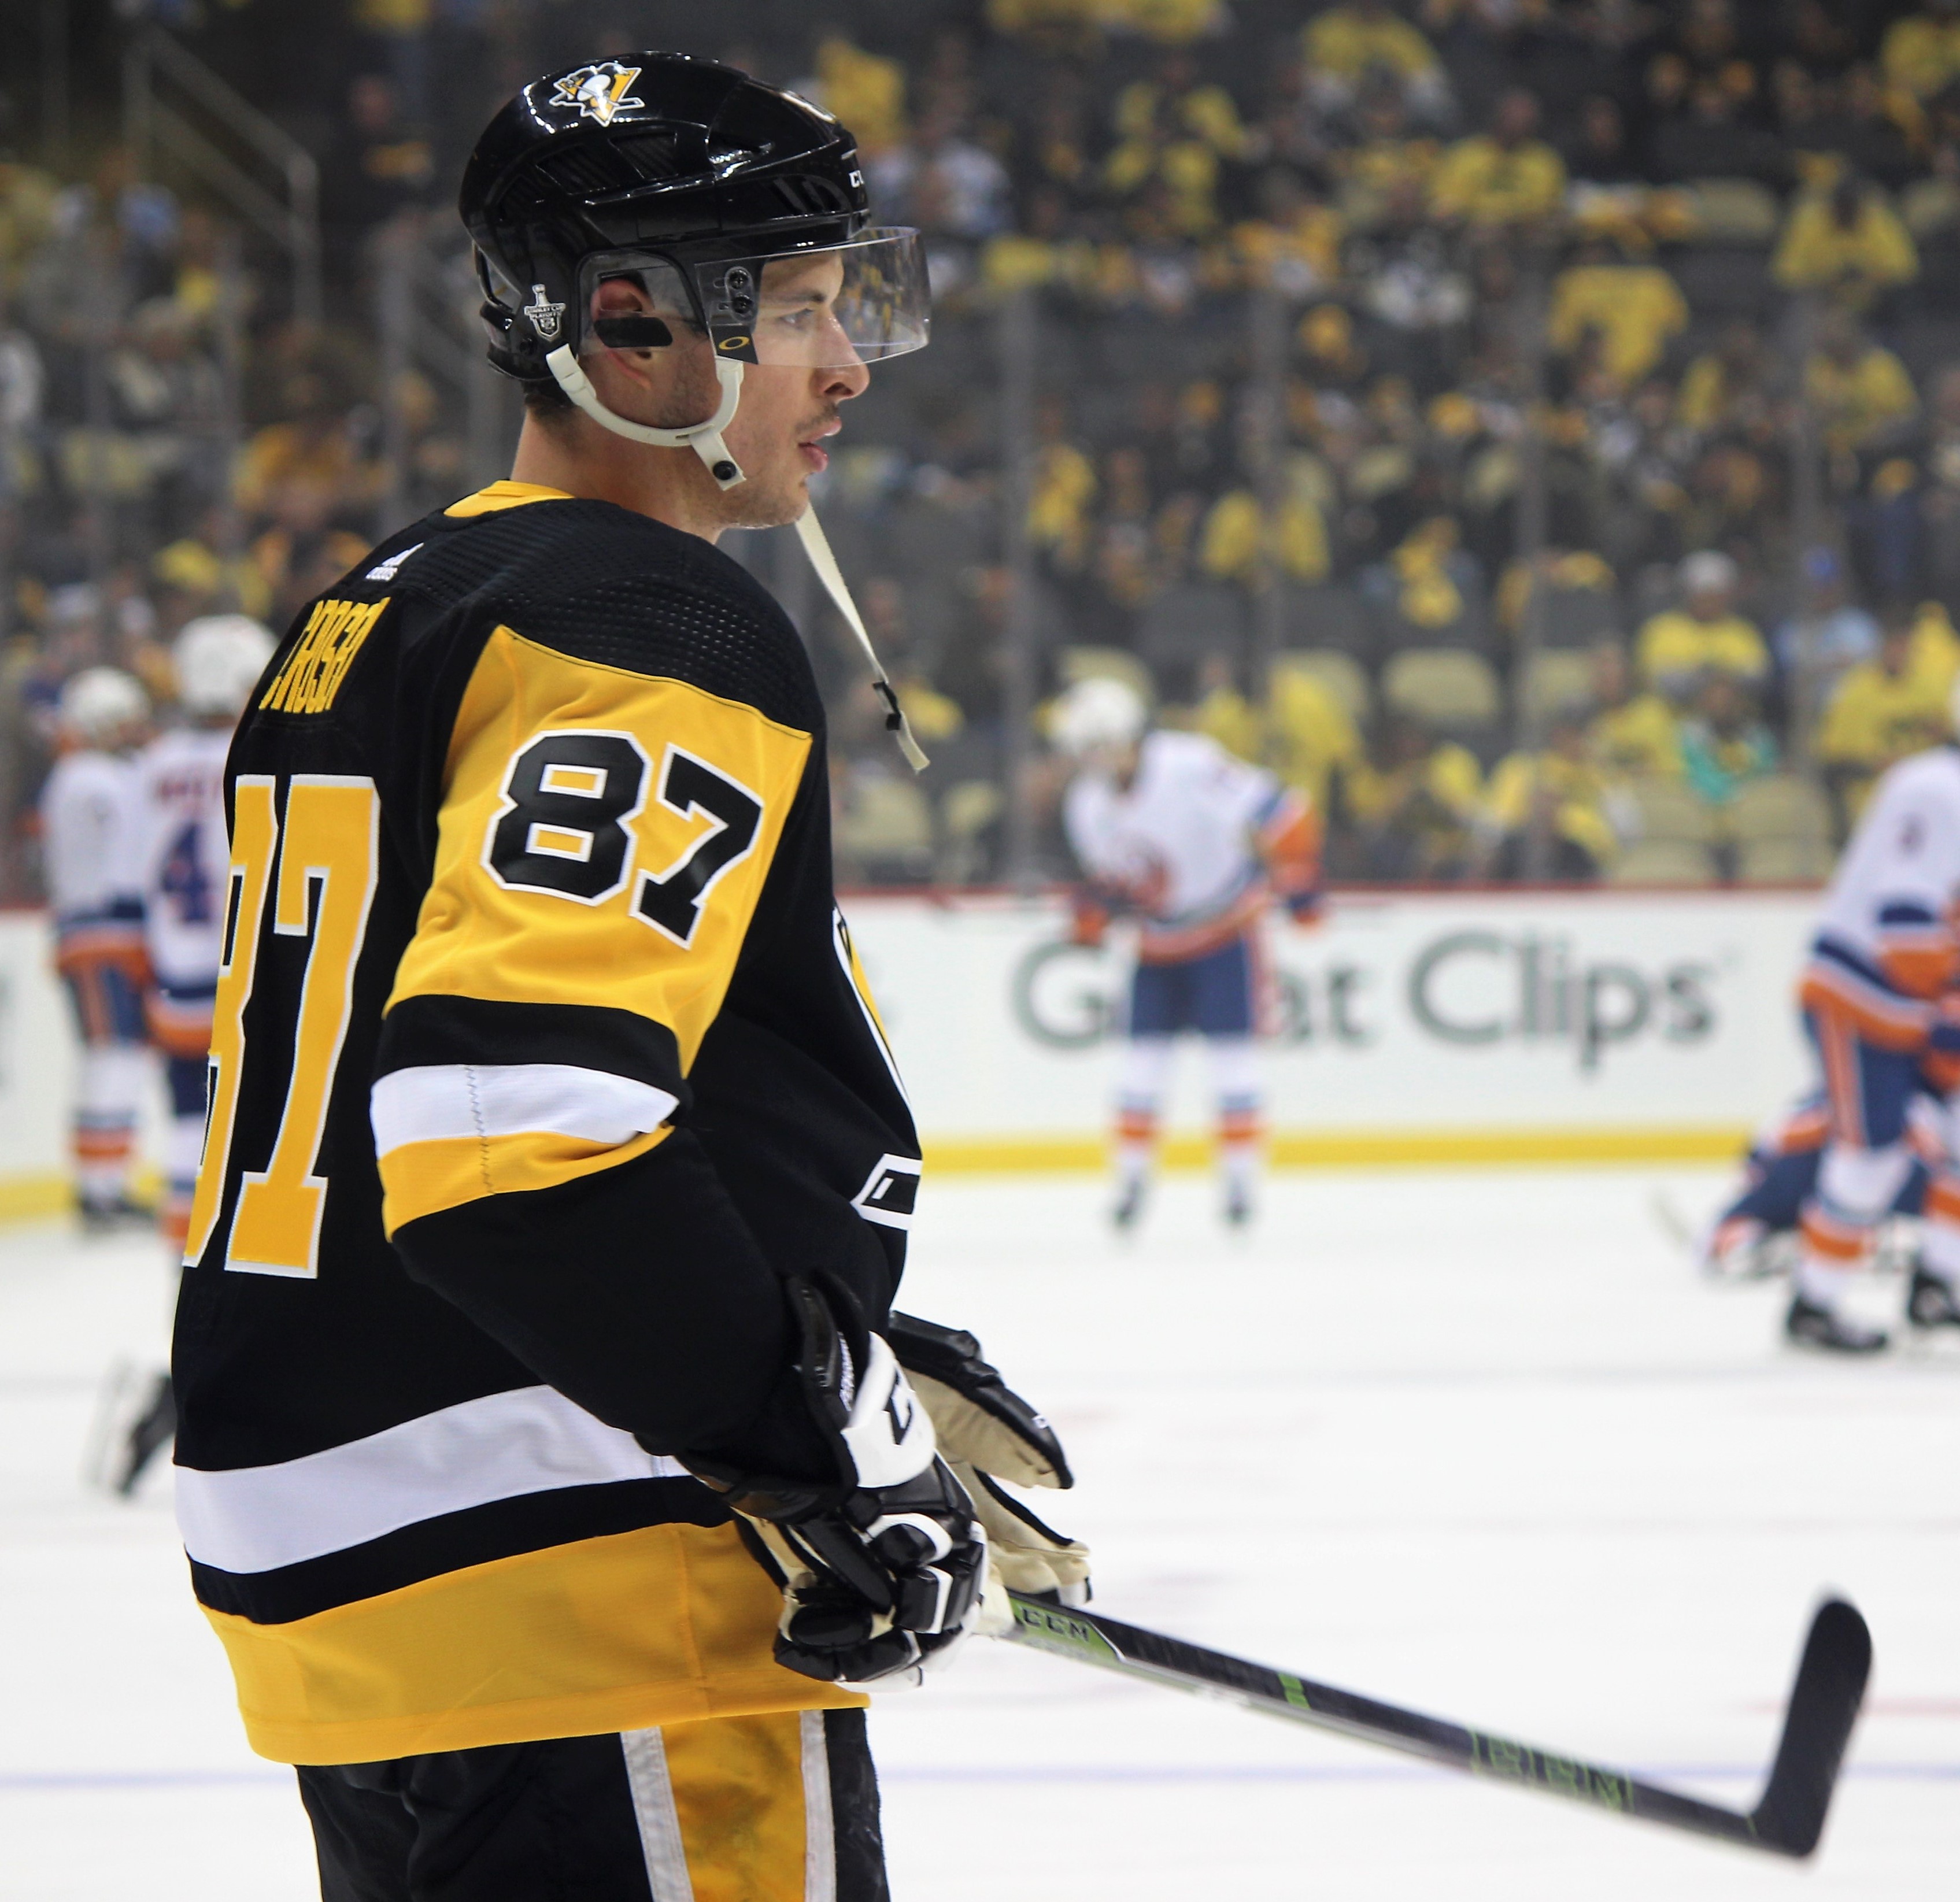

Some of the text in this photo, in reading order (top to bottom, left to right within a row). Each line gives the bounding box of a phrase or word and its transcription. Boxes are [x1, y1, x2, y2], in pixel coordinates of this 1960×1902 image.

[479, 728, 764, 950] 87
[1406, 928, 1715, 1070] Clips
[1021, 1608, 1090, 1643] CCM
